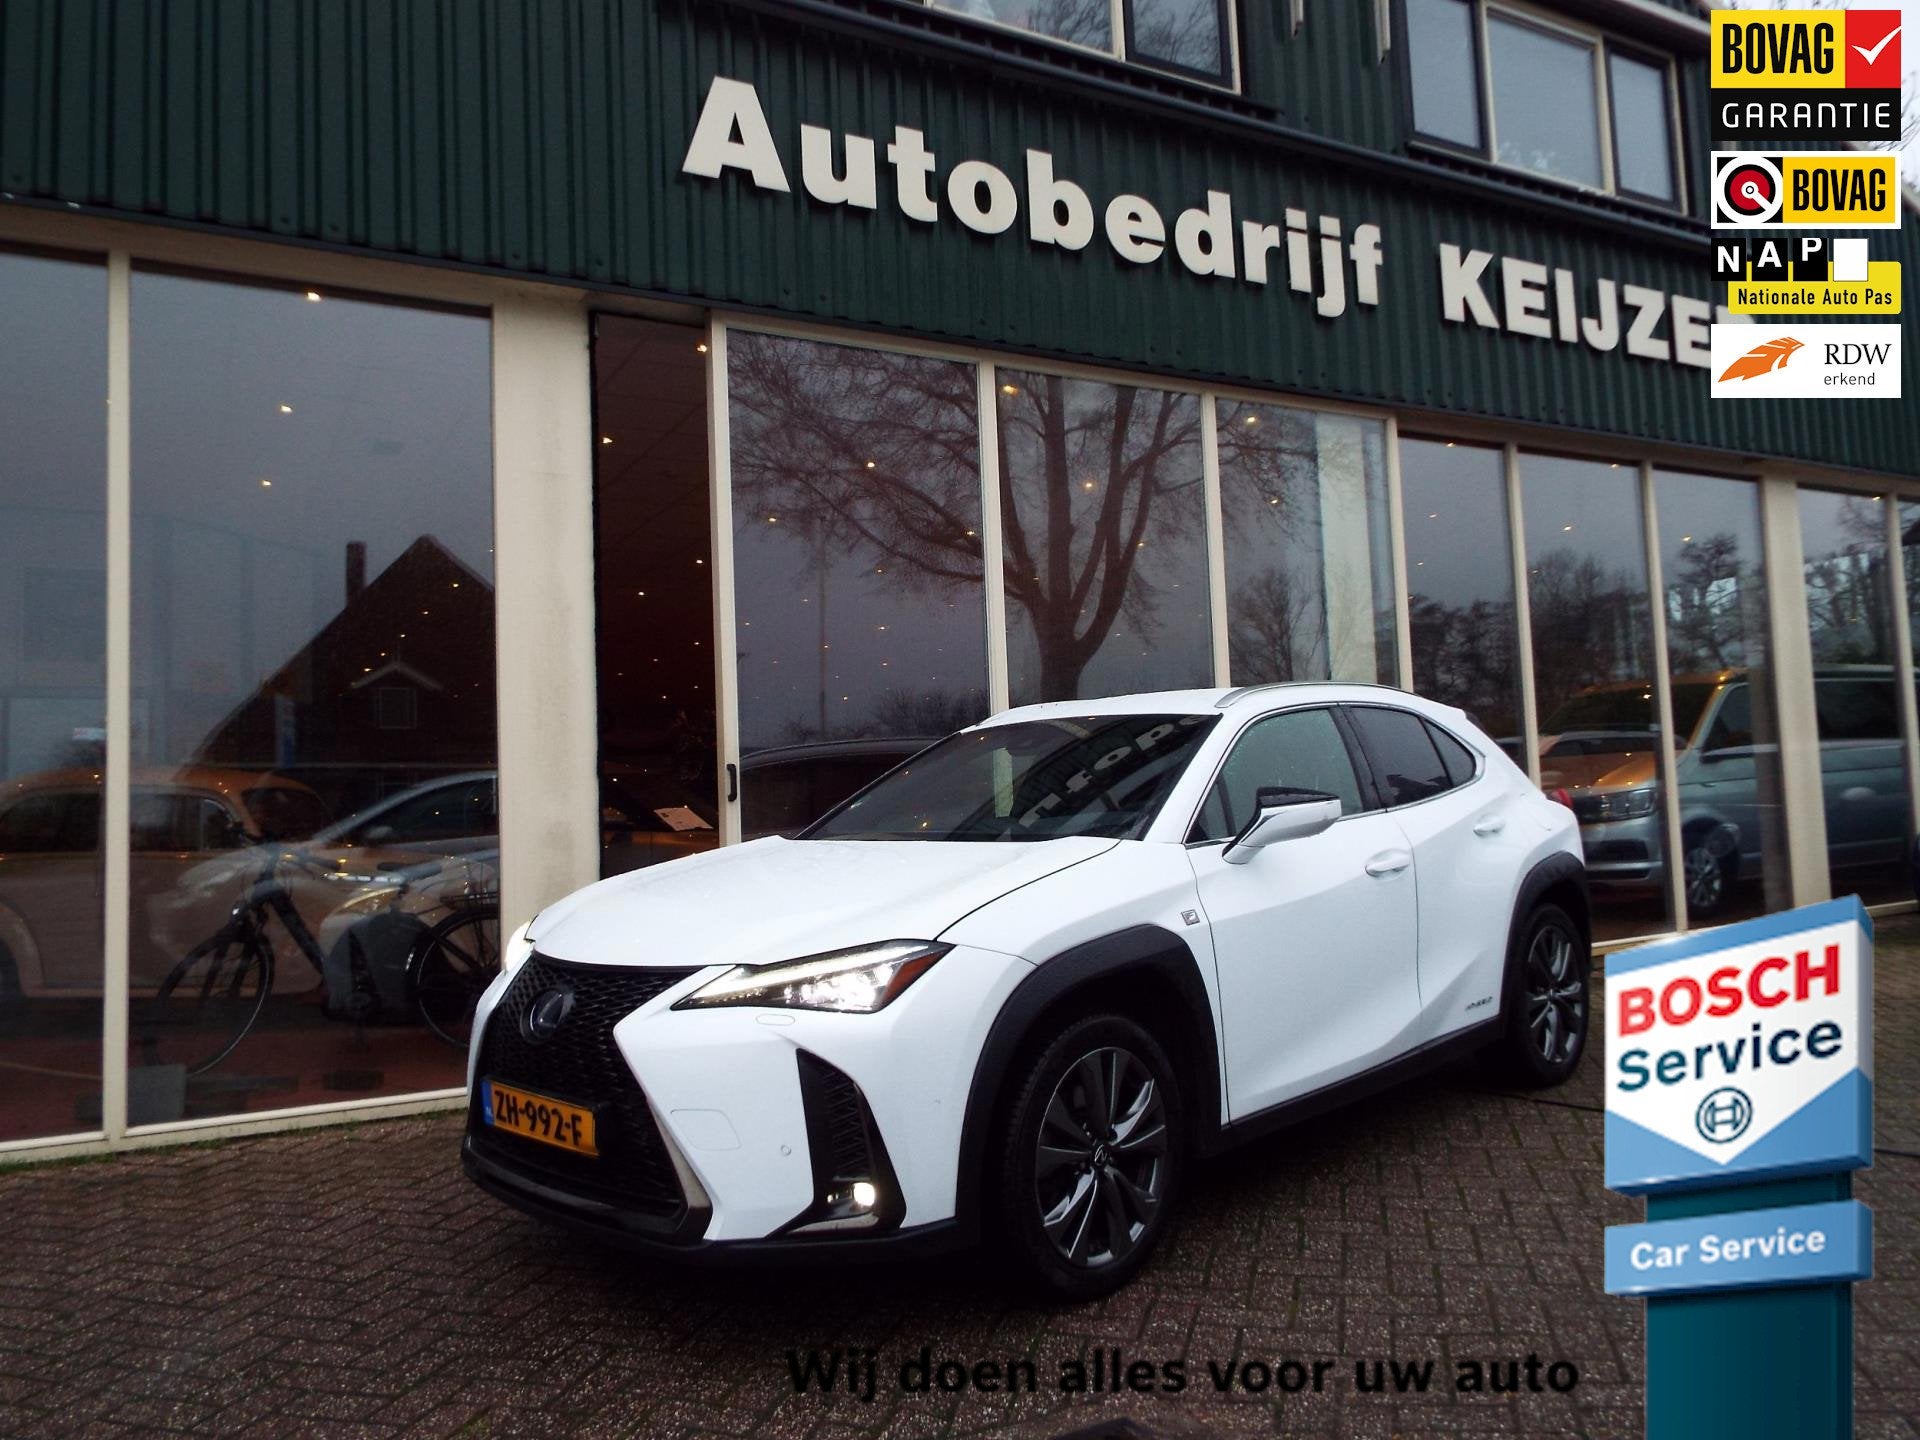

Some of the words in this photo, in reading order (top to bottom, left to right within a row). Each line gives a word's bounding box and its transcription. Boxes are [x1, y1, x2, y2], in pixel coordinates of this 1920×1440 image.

[682, 75, 1383, 318] Autobedrijf
[1439, 242, 1755, 369] KEIJZE
[494, 1089, 583, 1147] ZH-992-F
